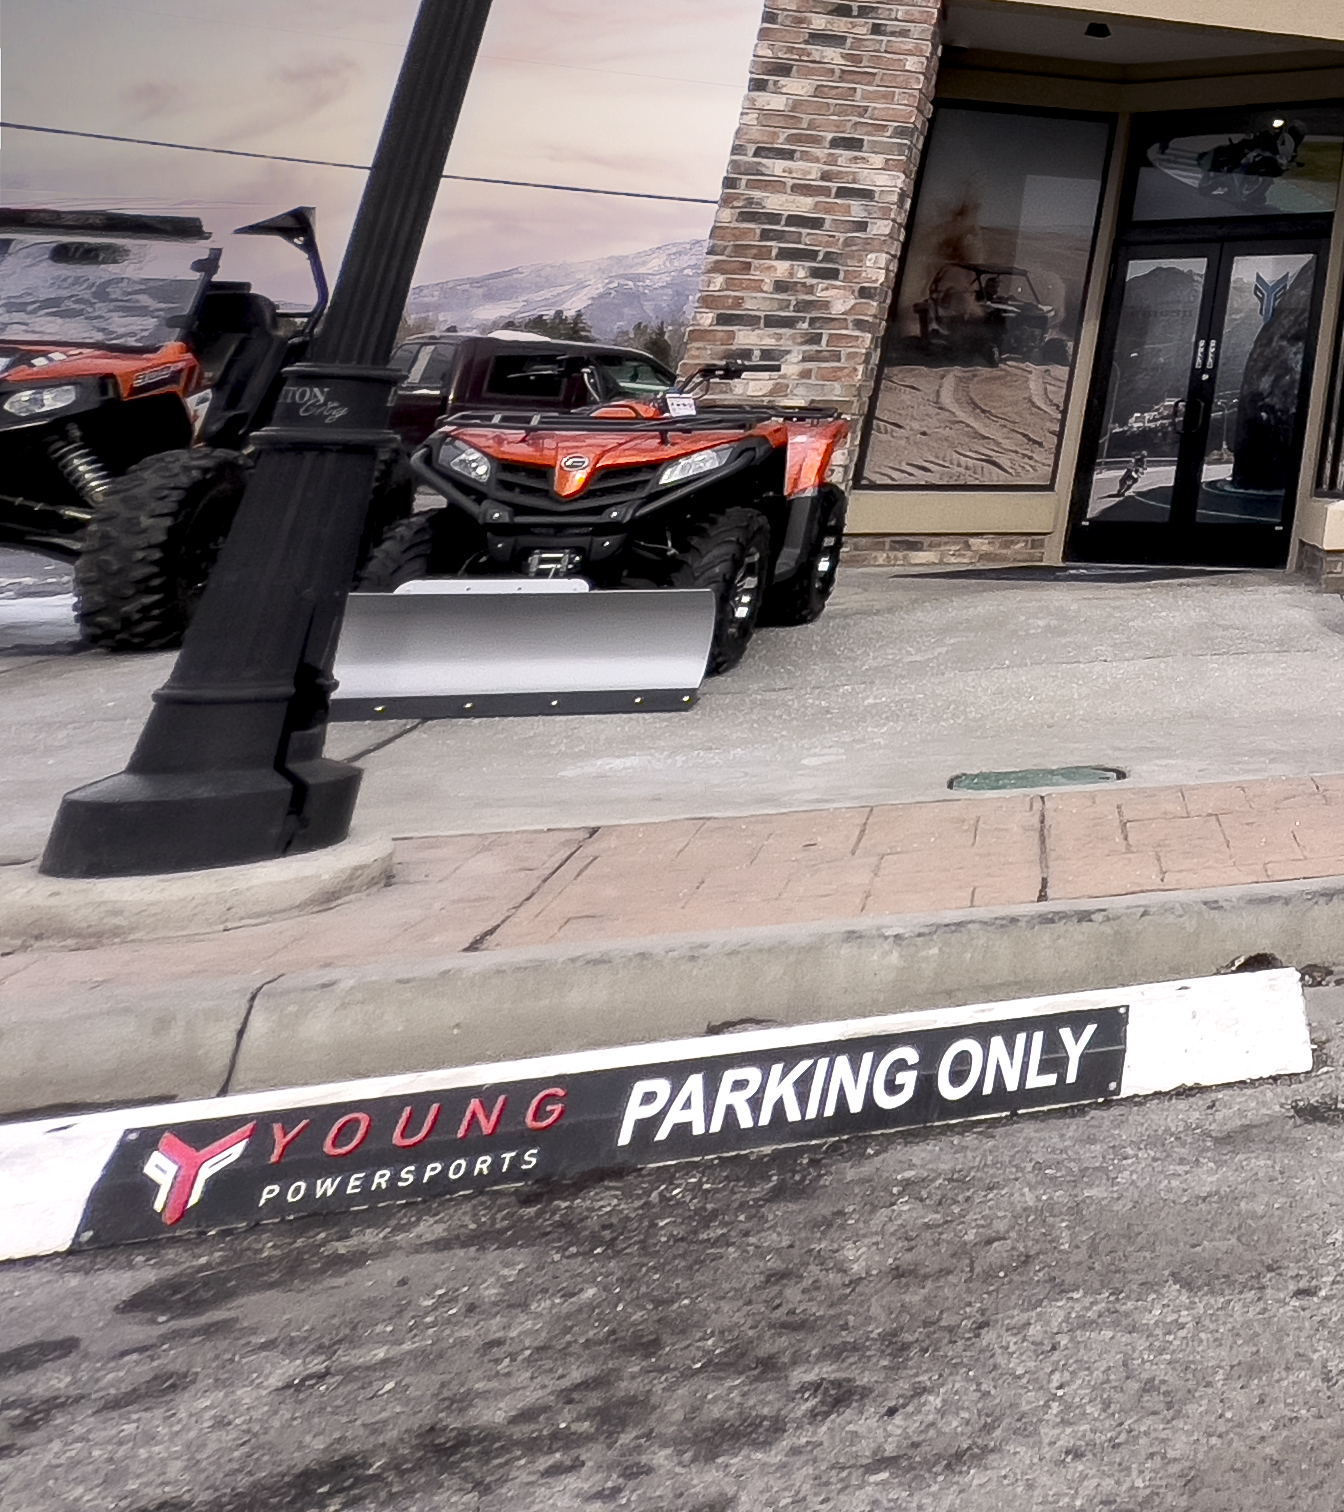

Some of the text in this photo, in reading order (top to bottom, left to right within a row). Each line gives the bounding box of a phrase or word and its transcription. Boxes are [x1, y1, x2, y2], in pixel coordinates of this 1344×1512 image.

[266, 1024, 1097, 1166] YOUNG PARKING ONLY
[258, 1147, 541, 1208] POWERSPORTS
